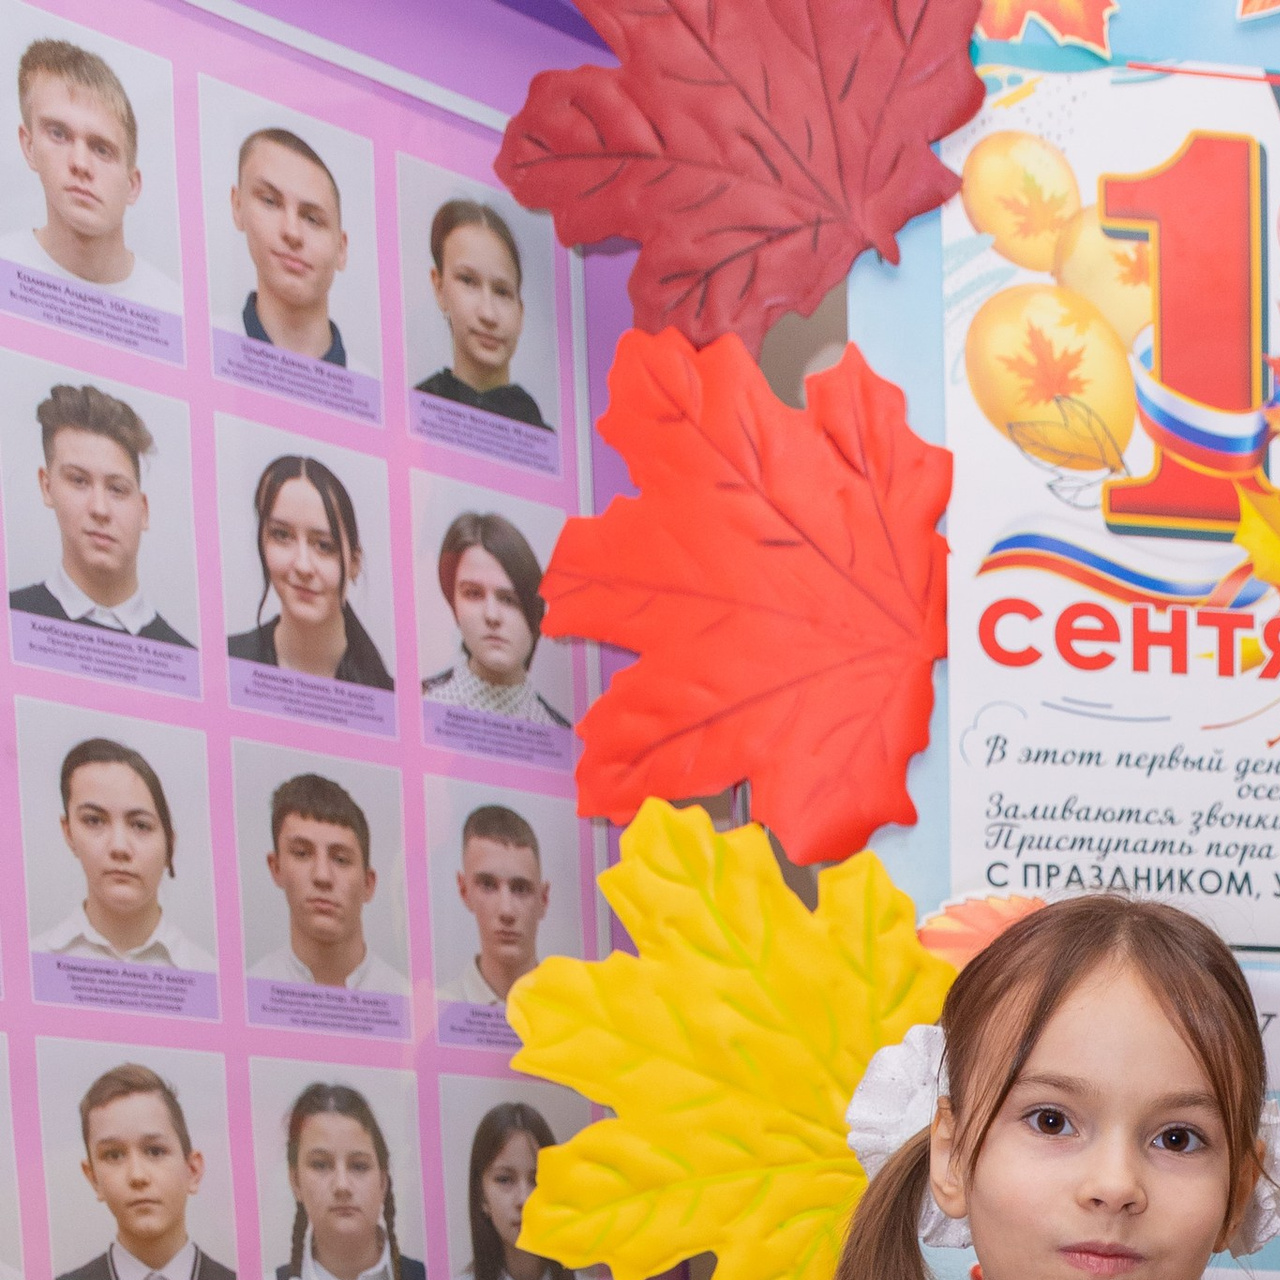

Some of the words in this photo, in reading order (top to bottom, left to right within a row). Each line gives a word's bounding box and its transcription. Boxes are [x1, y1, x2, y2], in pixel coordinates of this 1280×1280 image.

[985, 735, 1006, 768] В
[1017, 746, 1104, 769] этот
[1116, 745, 1225, 777] первый
[985, 794, 1181, 826] Заливаются
[984, 828, 1194, 860] Приступать
[1204, 838, 1279, 864] пора
[985, 862, 1009, 889] С
[1024, 863, 1262, 900] ПРАЗДНИКОМ,
